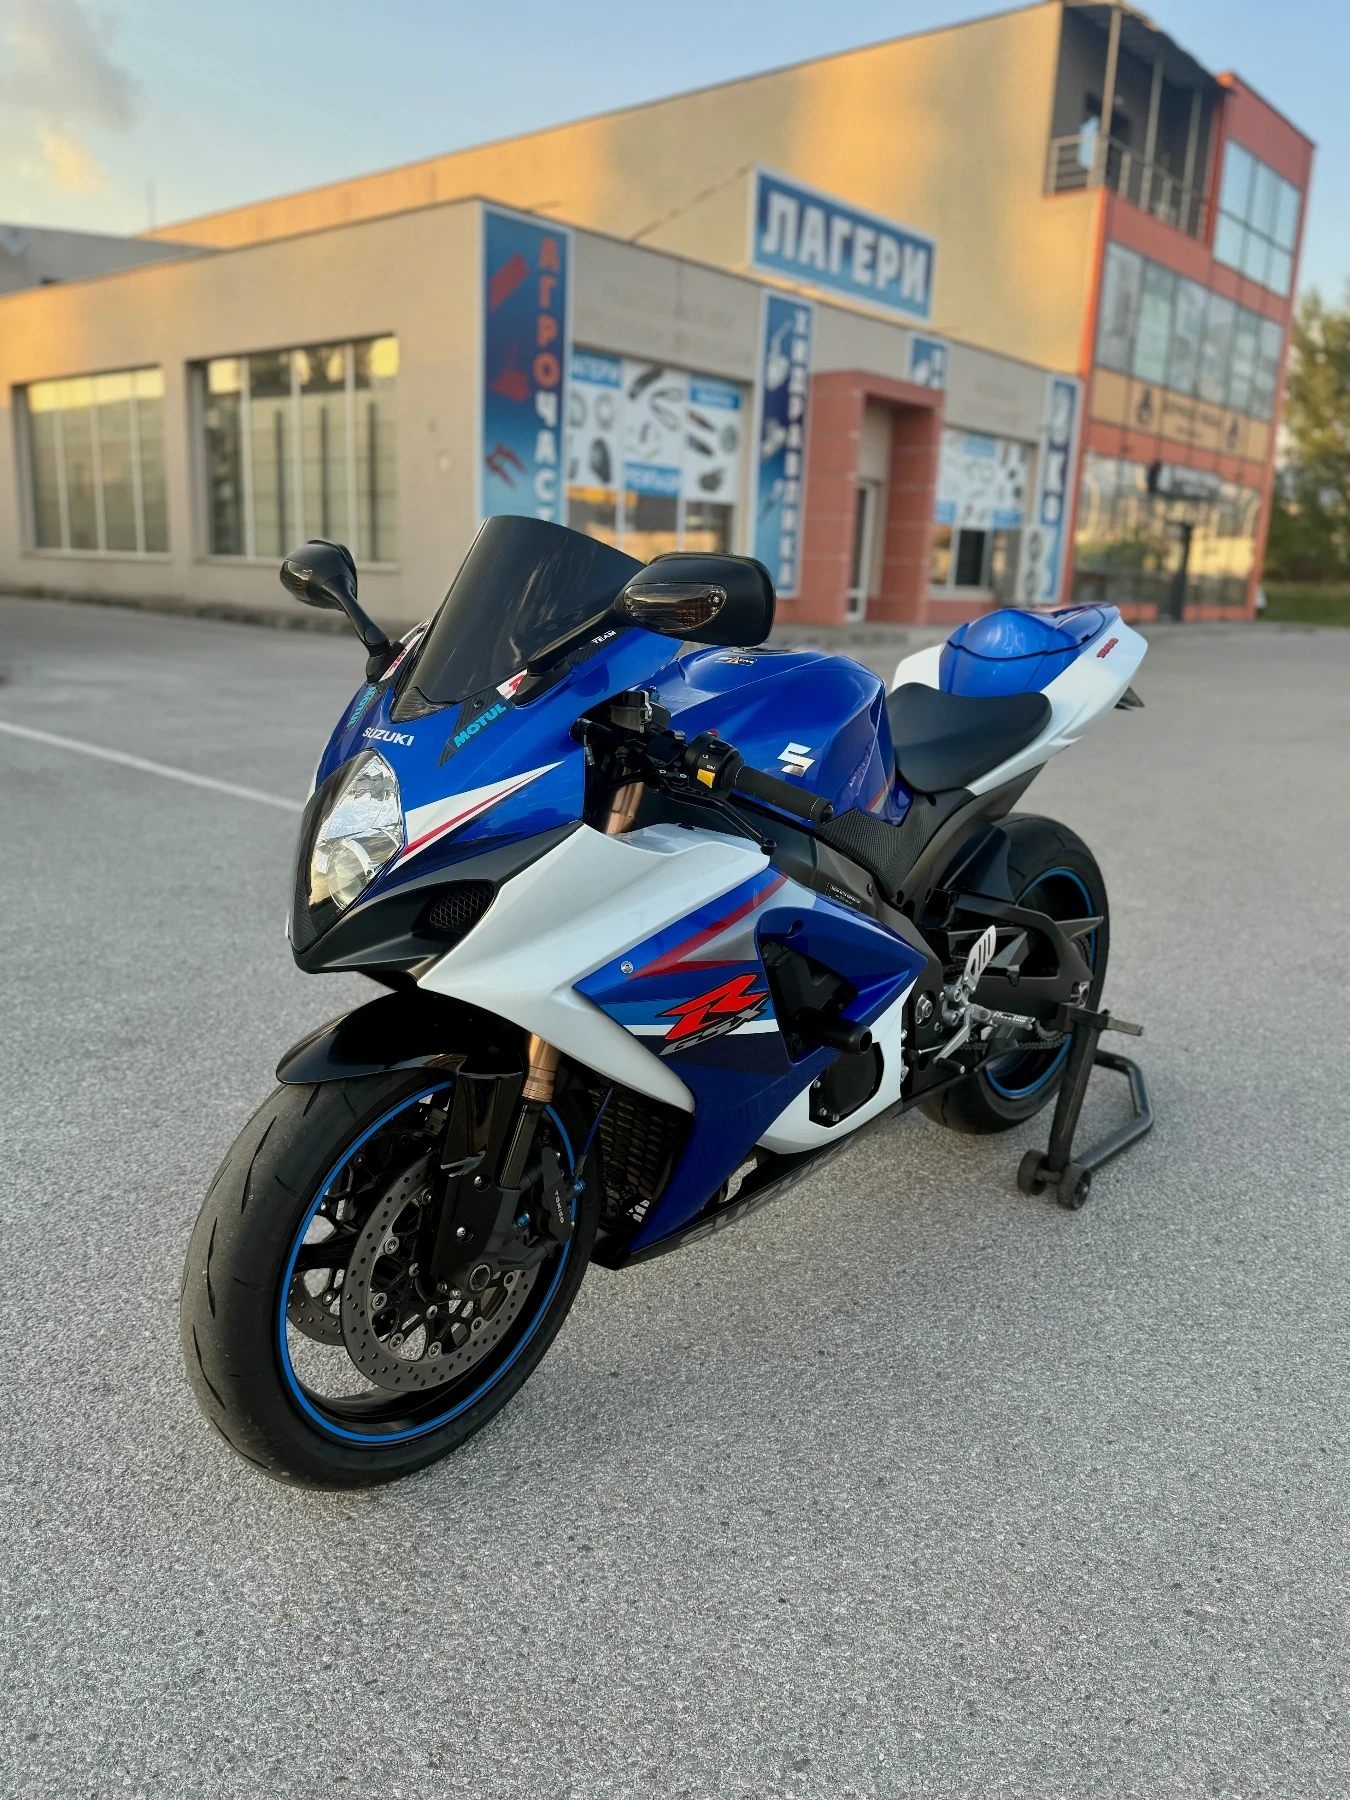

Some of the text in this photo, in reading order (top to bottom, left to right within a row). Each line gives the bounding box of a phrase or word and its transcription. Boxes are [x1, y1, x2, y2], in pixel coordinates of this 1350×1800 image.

[762, 190, 928, 304] ЛАГЕРИ
[590, 629, 617, 644] TEAM
[362, 727, 415, 747] SUZUKI
[453, 703, 507, 748] MOTUL
[554, 1189, 565, 1224] TOKICO
